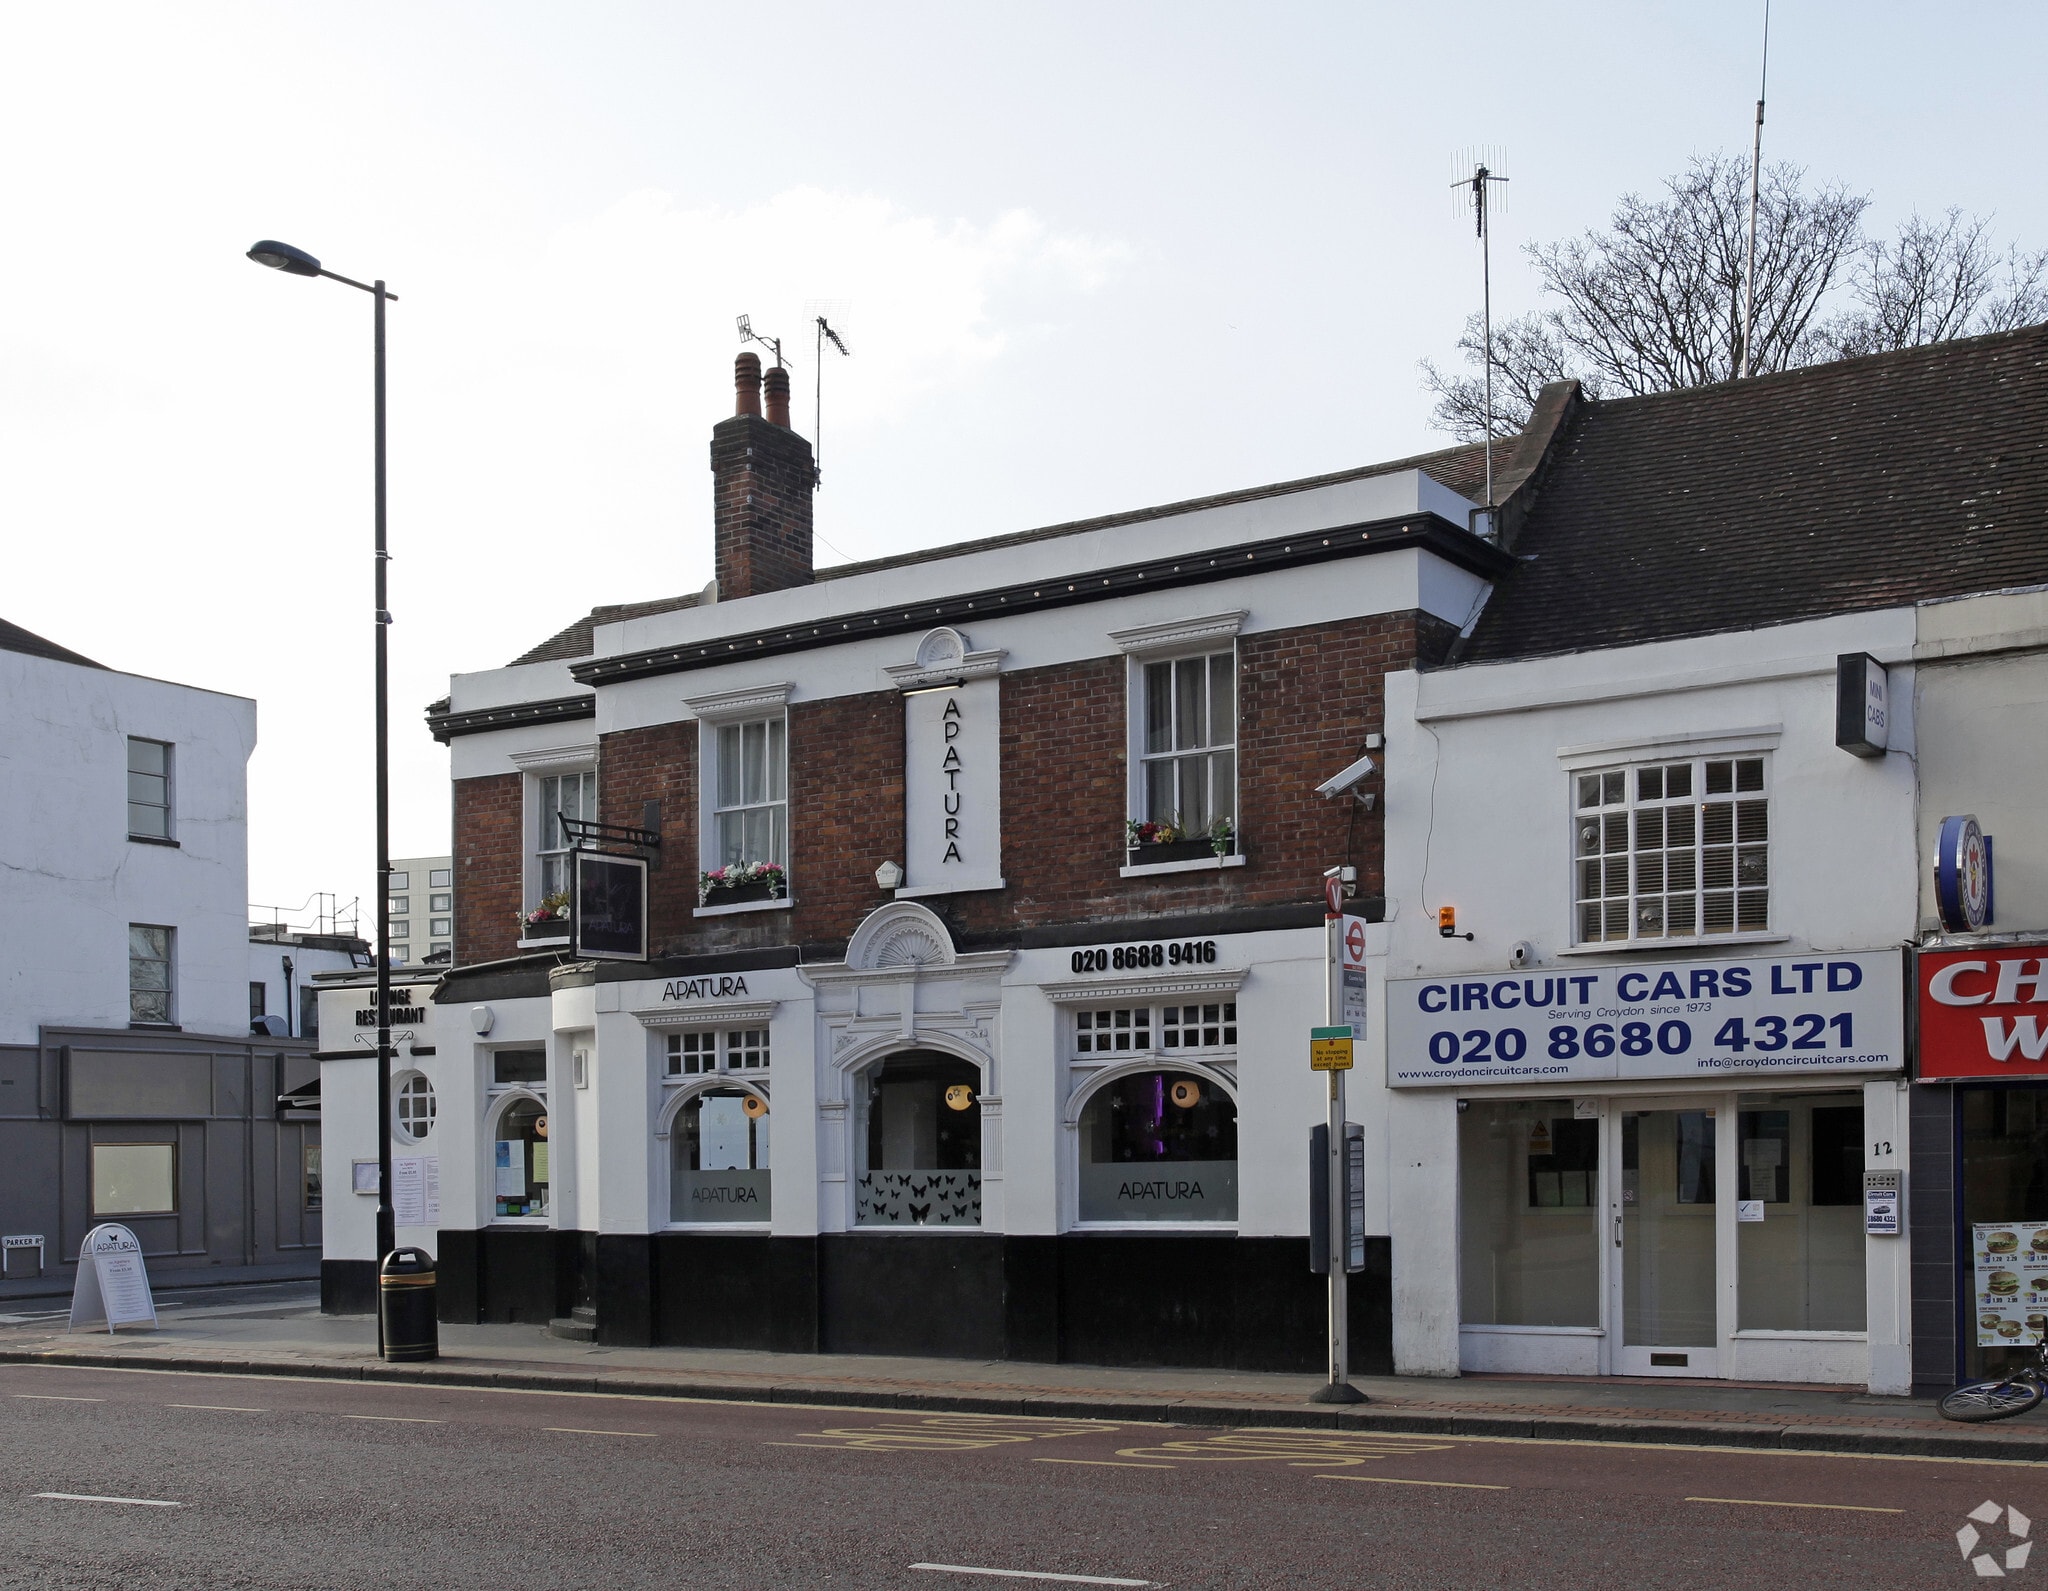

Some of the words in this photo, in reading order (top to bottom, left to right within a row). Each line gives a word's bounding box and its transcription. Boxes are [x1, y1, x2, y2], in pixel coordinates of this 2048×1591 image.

[1869, 680, 1882, 702] MINI
[1867, 705, 1885, 728] CABS
[943, 697, 962, 864] APATURA
[1332, 884, 1341, 912] V
[1071, 948, 1107, 974] 020
[1112, 944, 1164, 970] 8688
[1168, 940, 1216, 966] 9416
[662, 976, 748, 1001] APATURA
[1418, 976, 1598, 1012] CIRCUIT
[1617, 967, 1752, 1002] CARS
[1771, 962, 1863, 994] LTD
[356, 1007, 425, 1026] RESURANT
[1548, 1009, 1592, 1020] Serving
[1596, 1006, 1644, 1018] Croydon
[1650, 1004, 1680, 1014] since
[1686, 1002, 1712, 1013] 1973
[1429, 1028, 1526, 1064] 020
[1548, 1020, 1692, 1060] 8680
[1714, 1012, 1853, 1052] 4321
[1698, 1053, 1889, 1068] info@croydoncircuitcars.com
[1398, 1064, 1568, 1078] www.croydoncircuitcars.com
[1874, 1141, 1892, 1156] 12
[691, 1187, 758, 1203] APATURA
[1118, 1181, 1204, 1200] APATURA
[6, 1238, 32, 1246] PARKER
[96, 1242, 137, 1251] APATURA
